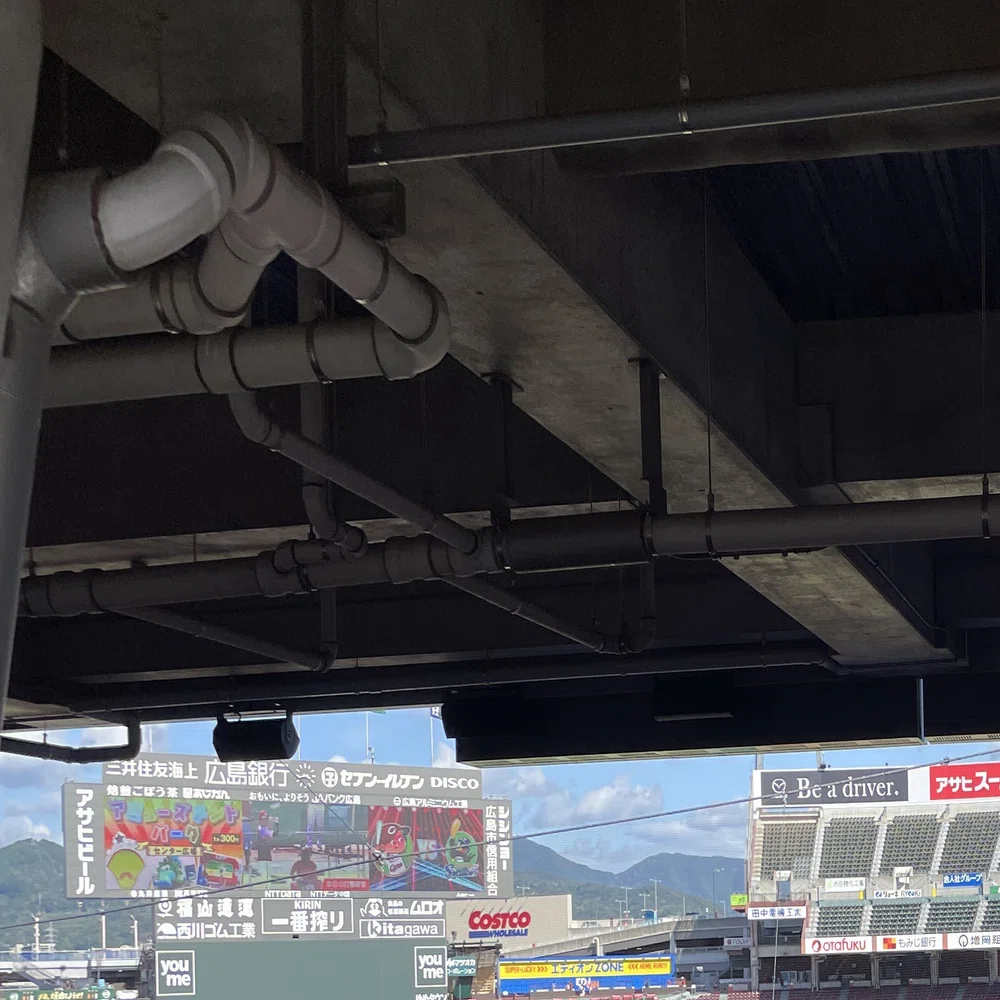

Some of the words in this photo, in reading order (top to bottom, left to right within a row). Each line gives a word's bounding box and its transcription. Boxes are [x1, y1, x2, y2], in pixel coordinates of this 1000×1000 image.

[106, 760, 198, 779] 三井住友海上
[204, 759, 290, 787] 広島銀行
[430, 777, 480, 789] DISCO
[797, 777, 822, 799] Be
[842, 776, 899, 798] driver.
[76, 789, 95, 895] アサヒビール
[151, 824, 200, 844] パーク
[417, 839, 438, 860] VS
[486, 805, 498, 897] 広島市信用組合
[176, 898, 254, 918] 福山通運
[294, 900, 321, 909] KIRIN
[410, 900, 444, 915] ムロオ
[271, 910, 344, 932] 一番搾り
[468, 910, 531, 930] COSTCO
[177, 922, 256, 939] 西川ゴム工業
[487, 928, 528, 938] WHOLESALE
[899, 936, 937, 949] もみじ銀行
[160, 959, 189, 975] you
[418, 954, 442, 969] you
[166, 973, 191, 986] me
[422, 966, 443, 979] me
